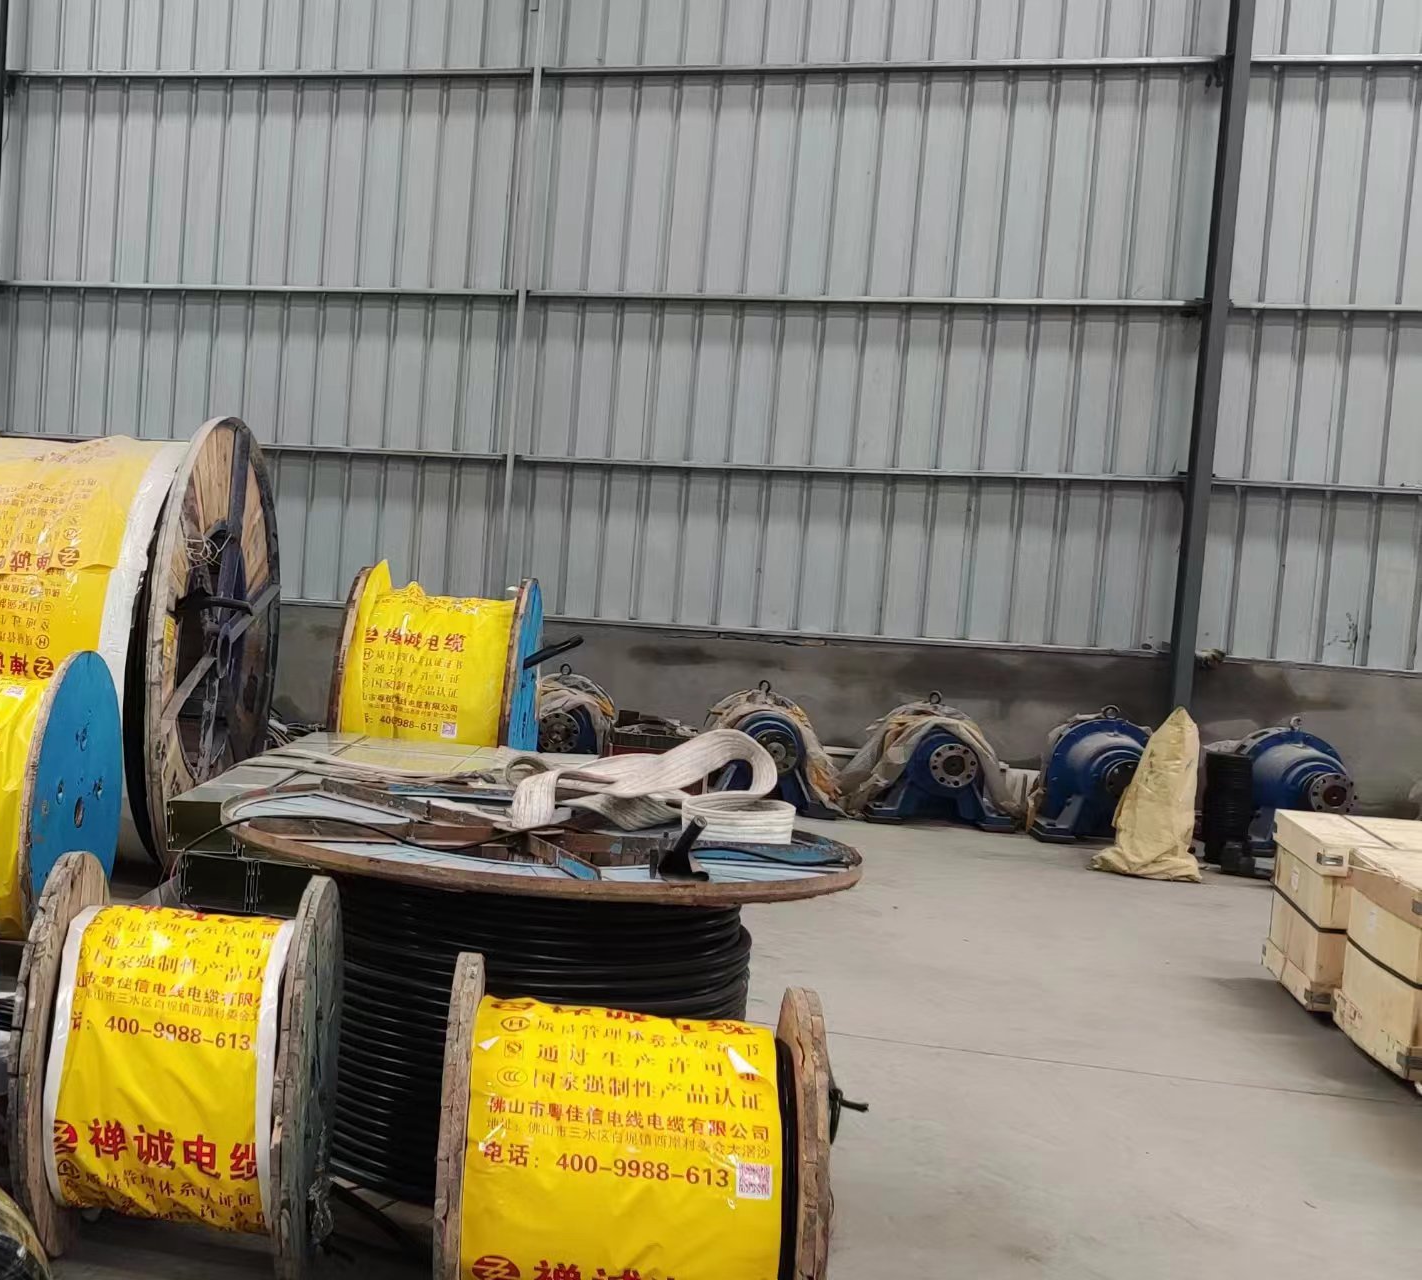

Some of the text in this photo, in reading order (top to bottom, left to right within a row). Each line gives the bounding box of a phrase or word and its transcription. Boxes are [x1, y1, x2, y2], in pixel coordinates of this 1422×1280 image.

[104, 1014, 252, 1051] 400-9988-613
[537, 1043, 760, 1082] 通过生产许可
[533, 1068, 763, 1112] 国家强制性产品认证
[487, 1095, 771, 1142] 佛山市粤佳信电线电缆有限公司
[482, 1140, 730, 1188] 电话： 400-9988-613
